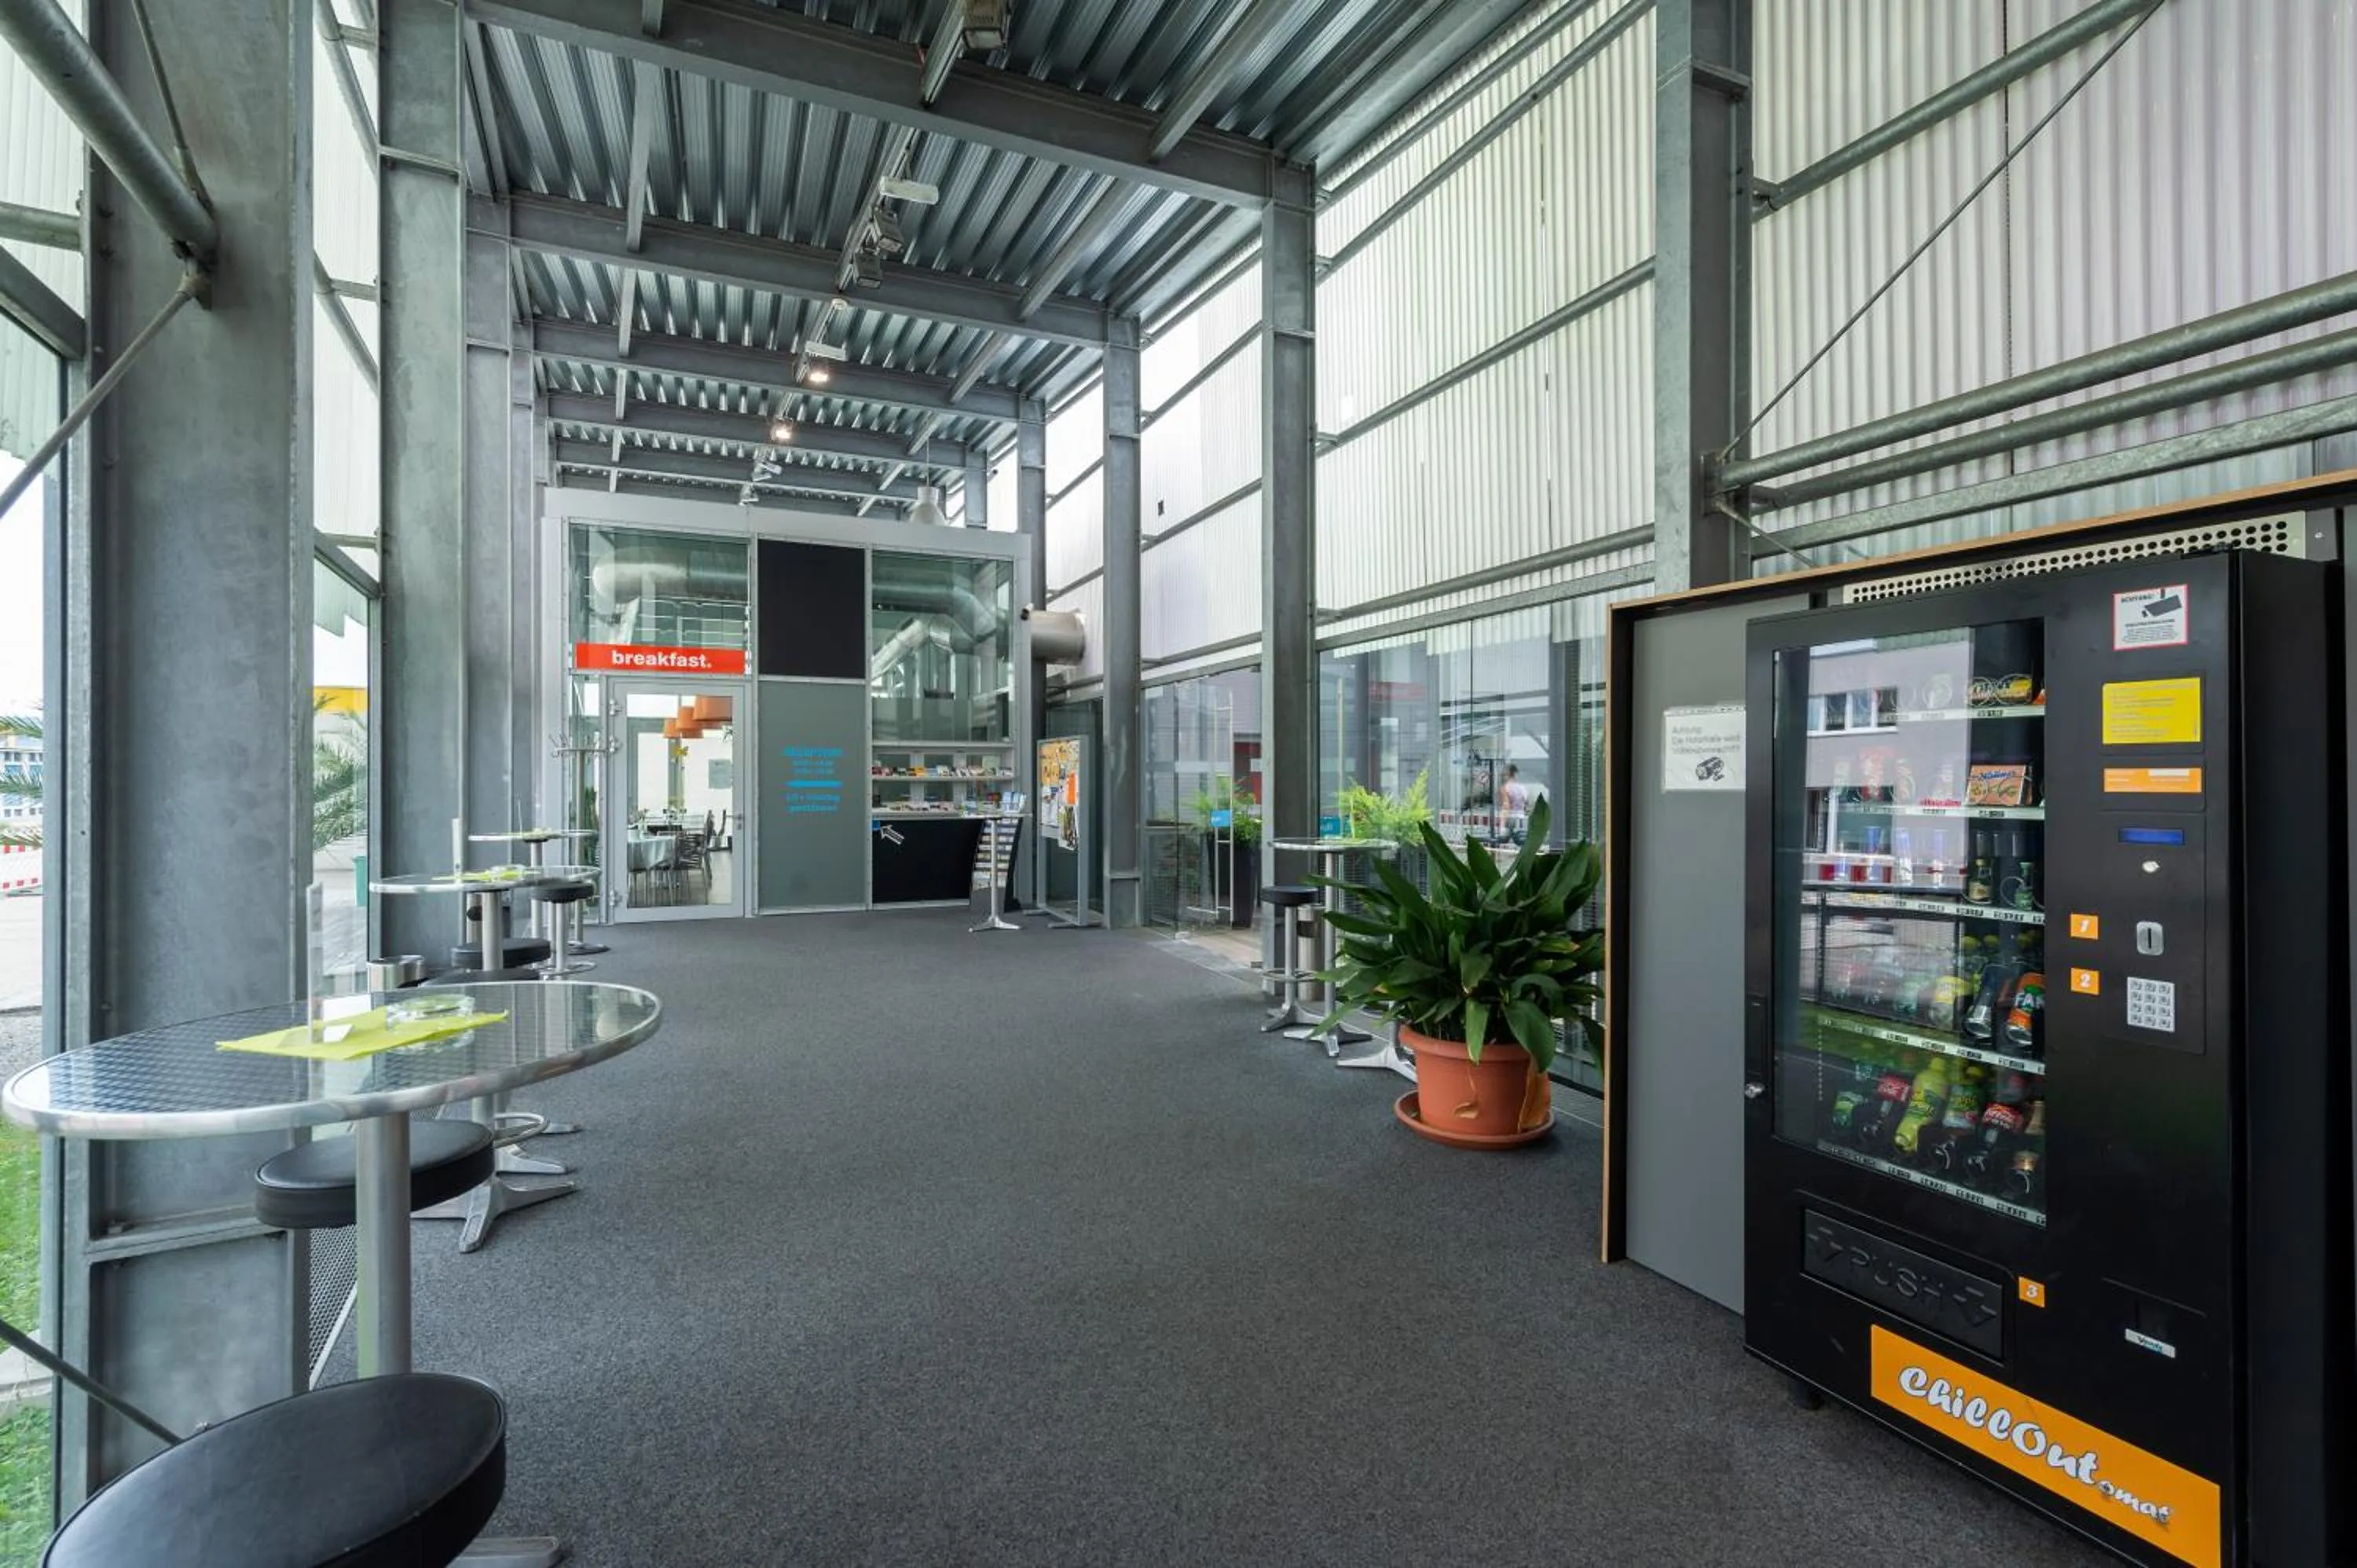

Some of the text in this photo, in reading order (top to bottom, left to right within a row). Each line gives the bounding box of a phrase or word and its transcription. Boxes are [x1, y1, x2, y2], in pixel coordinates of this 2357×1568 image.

[611, 650, 712, 669] breakfast.
[2080, 919, 2089, 932] 1
[2080, 973, 2091, 987] 2
[2026, 1284, 2037, 1298] 3
